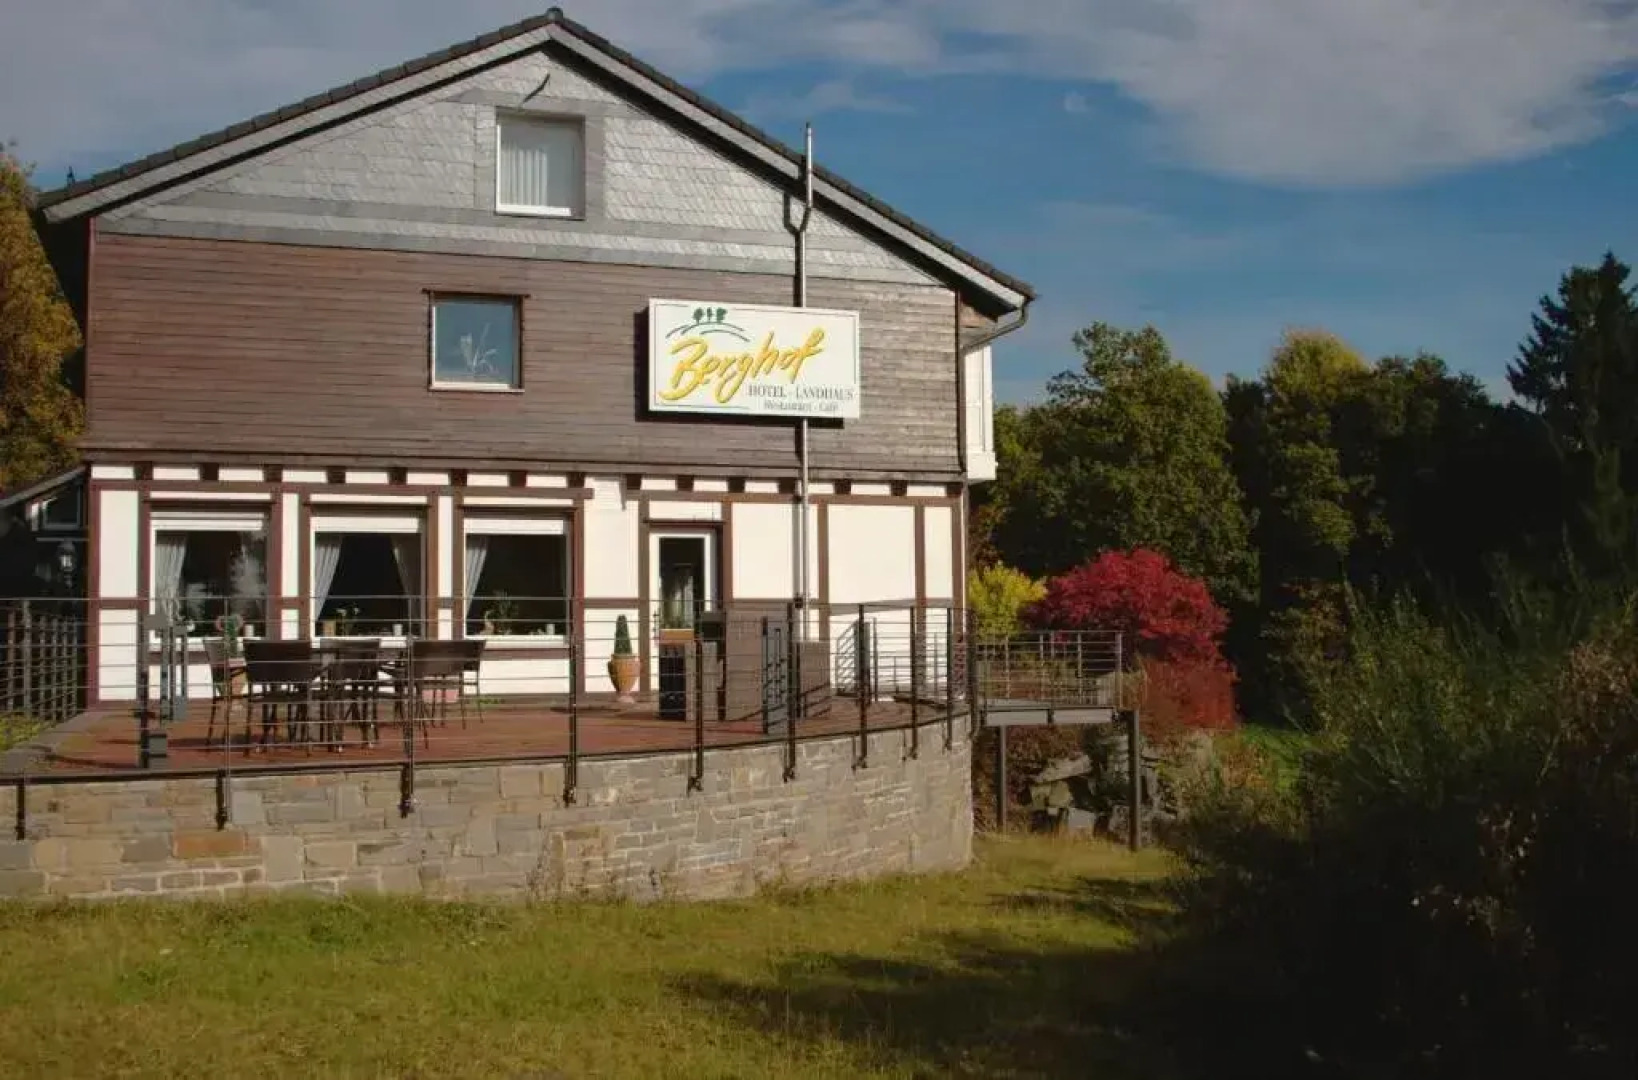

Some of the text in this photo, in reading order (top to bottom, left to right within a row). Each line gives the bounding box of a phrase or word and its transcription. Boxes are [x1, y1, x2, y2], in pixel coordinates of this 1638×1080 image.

[658, 326, 825, 404] Berghof
[748, 384, 787, 398] HOTEL
[795, 386, 854, 401] LANDHAUS
